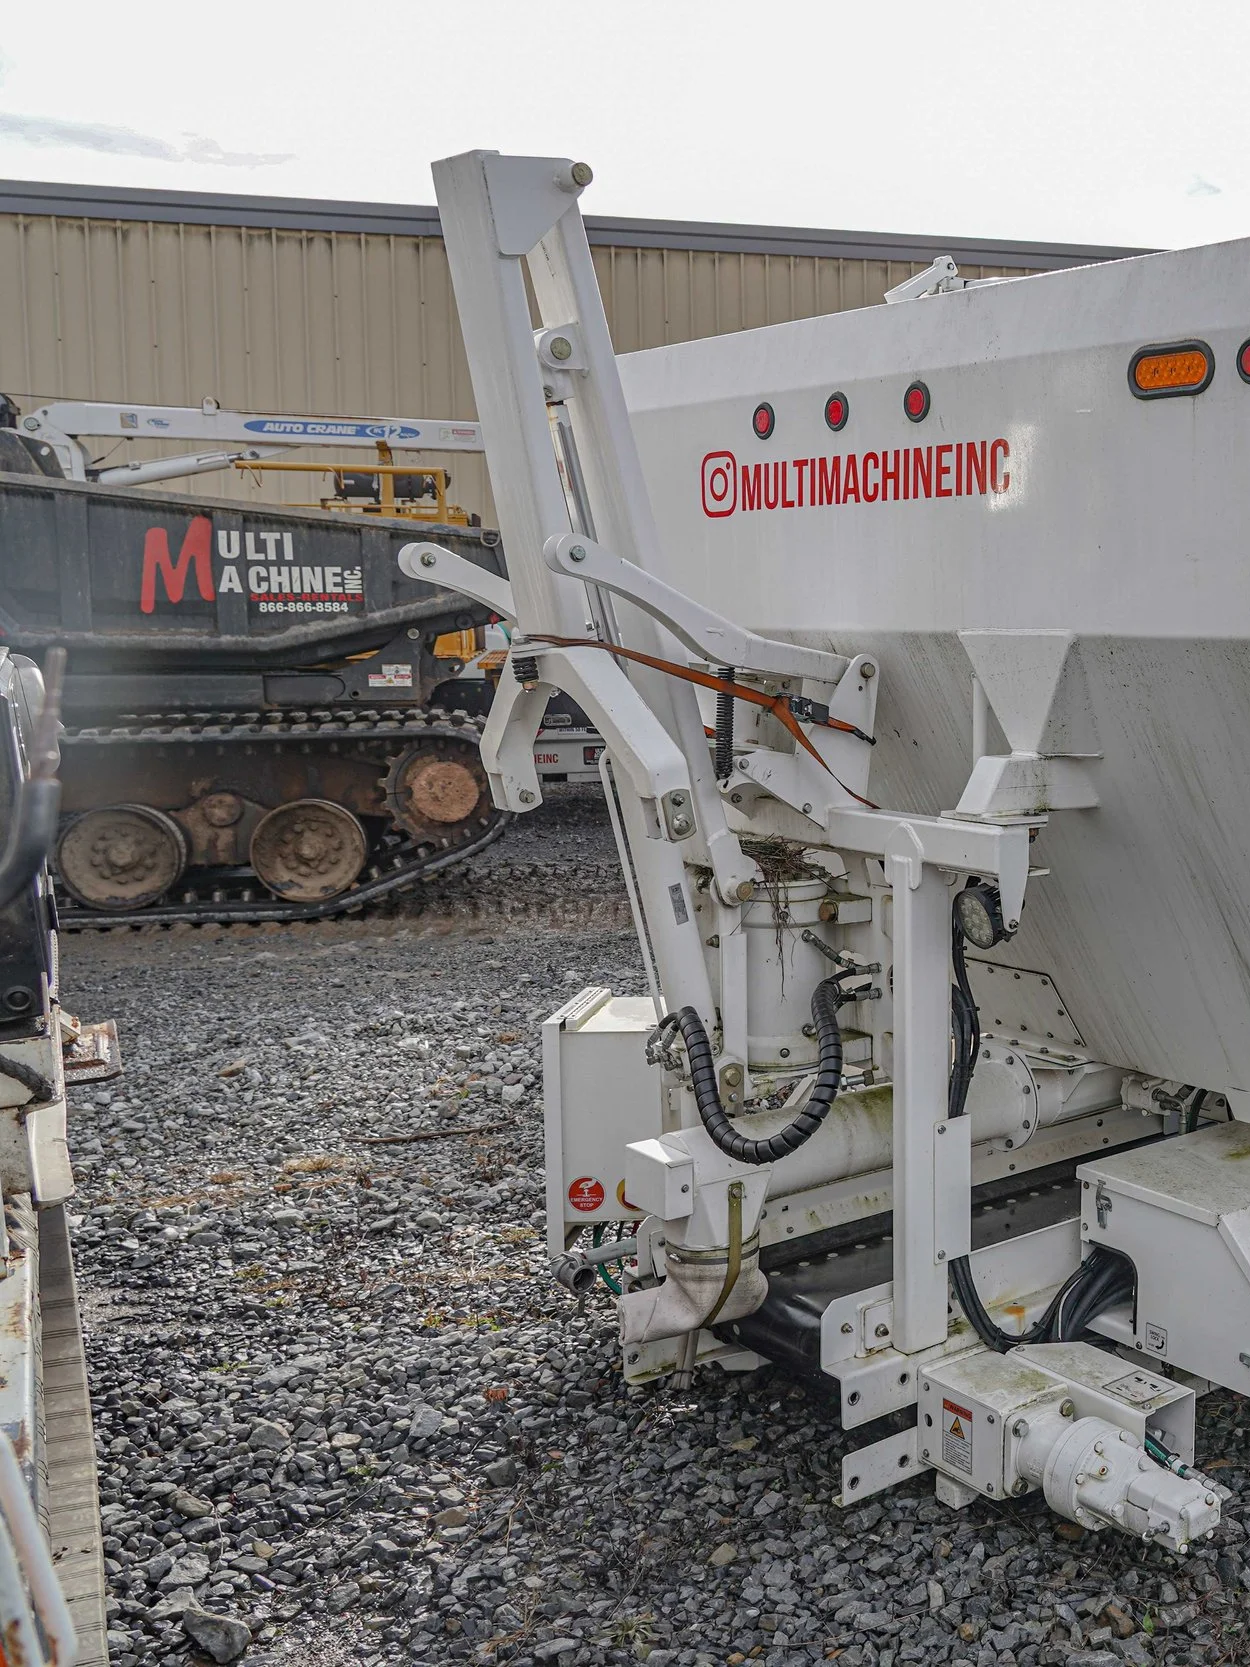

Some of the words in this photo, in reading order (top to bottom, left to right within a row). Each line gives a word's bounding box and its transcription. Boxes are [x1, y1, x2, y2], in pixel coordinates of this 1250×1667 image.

[262, 421, 304, 433] AUTO
[306, 423, 357, 435] CRANE
[383, 424, 402, 440] 12
[741, 438, 1010, 512] MULTIMACHINEINC
[259, 602, 349, 613] 866-866-8584
